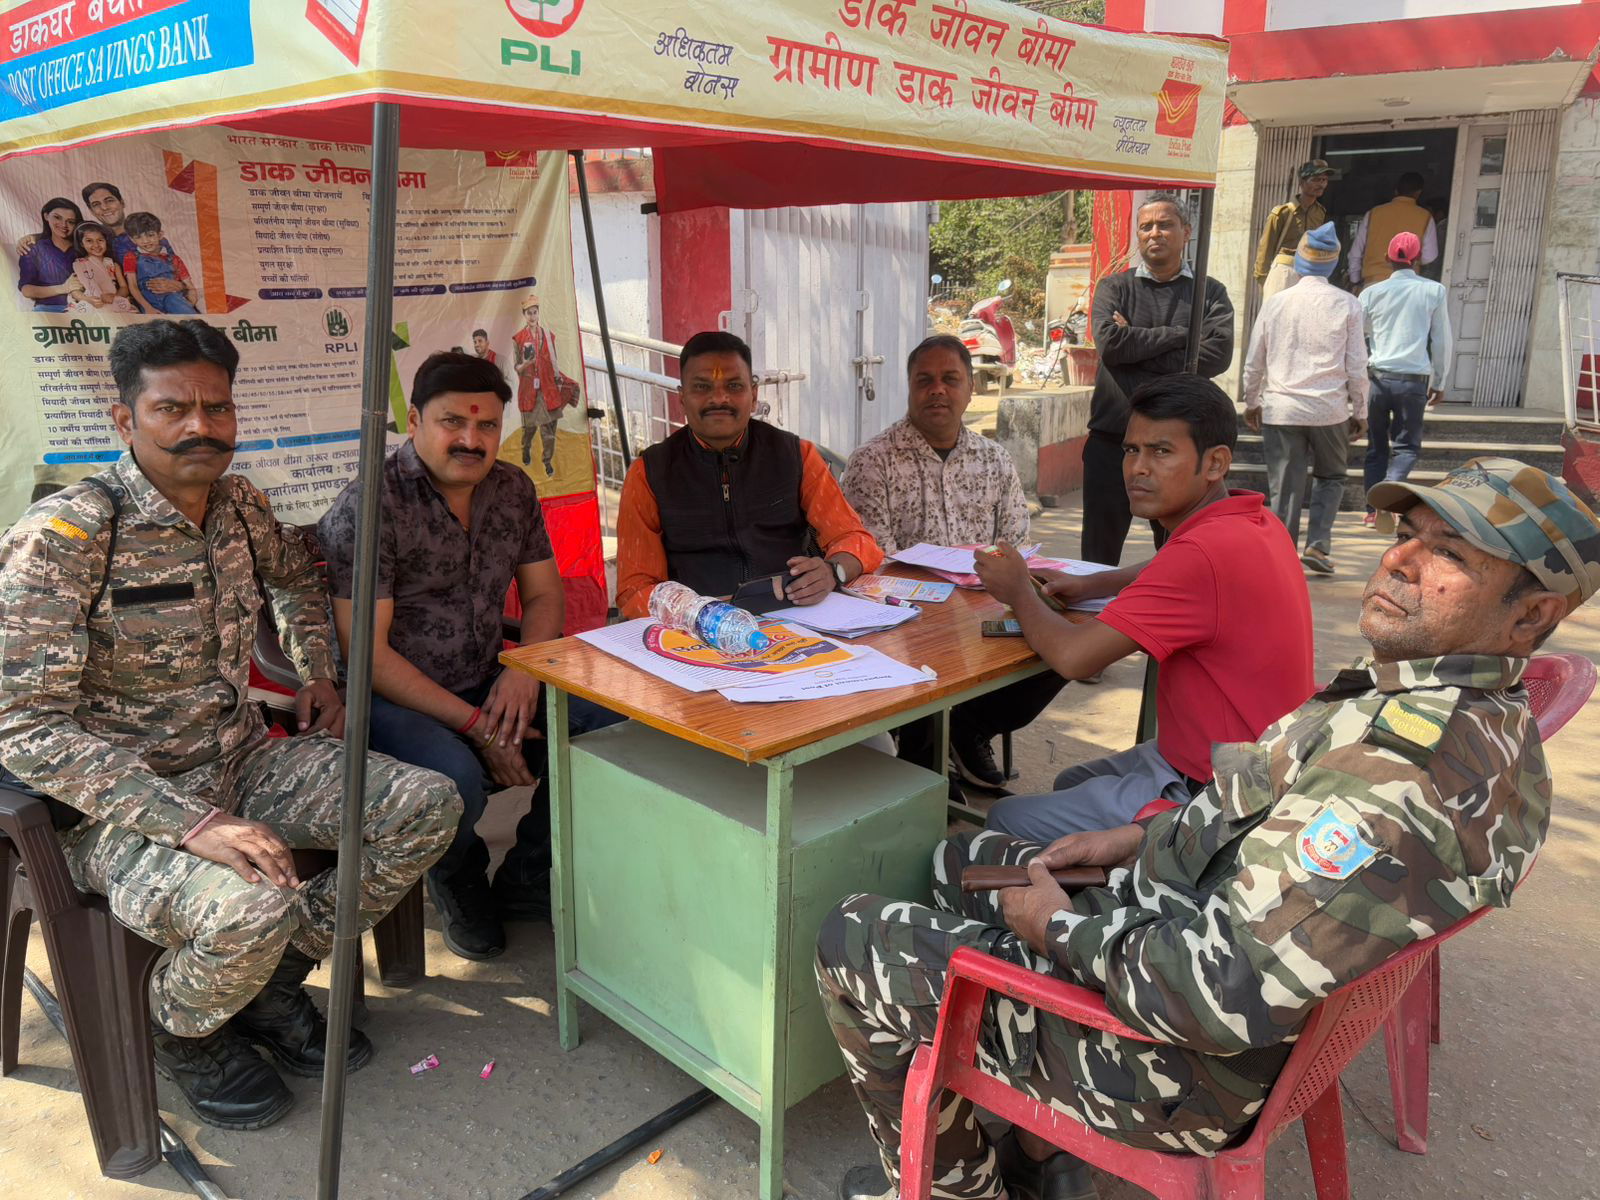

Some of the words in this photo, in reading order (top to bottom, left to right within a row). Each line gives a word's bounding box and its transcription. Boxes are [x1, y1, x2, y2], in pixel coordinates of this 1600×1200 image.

[9, 1, 76, 53] डाकघर
[838, 0, 916, 37] डाक
[930, 0, 1009, 58] जीवन
[1017, 17, 1076, 73] बीमा
[501, 38, 581, 76] PLI
[654, 27, 733, 66] अधिकतम
[8, 65, 37, 106] POST
[37, 51, 85, 100] OFFICE
[85, 30, 156, 86] SAVINGS
[157, 14, 212, 69] BANK
[684, 63, 739, 100] बोनस
[766, 31, 880, 97] ग्रामीण
[894, 61, 958, 109] डाक
[971, 66, 1040, 123] जीवन
[1050, 82, 1099, 132] बीमा
[1113, 116, 1148, 134] न्यूनतम
[227, 135, 256, 146] भारत
[260, 136, 298, 149] सरकार
[306, 141, 332, 151] डाक
[336, 142, 366, 154] विभाग
[1115, 134, 1151, 155] प्रीमियम
[238, 160, 296, 183] डाक
[302, 158, 371, 185] जीवन
[397, 171, 427, 189] मा
[249, 188, 266, 197] डाक
[269, 188, 290, 197] जीवन
[293, 188, 310, 198] बीमा
[32, 319, 110, 348] ग्रामीण
[232, 319, 277, 343] बीमा
[325, 342, 358, 353] RPLI
[32, 355, 55, 363] डाक
[58, 354, 82, 362] जीवन
[85, 354, 103, 362] बीमा
[63, 368, 84, 378] जीवन
[70, 396, 90, 406] जीवन
[72, 437, 82, 446] की
[290, 462, 333, 479] कार्यालय
[262, 484, 310, 499] हजारीबाग
